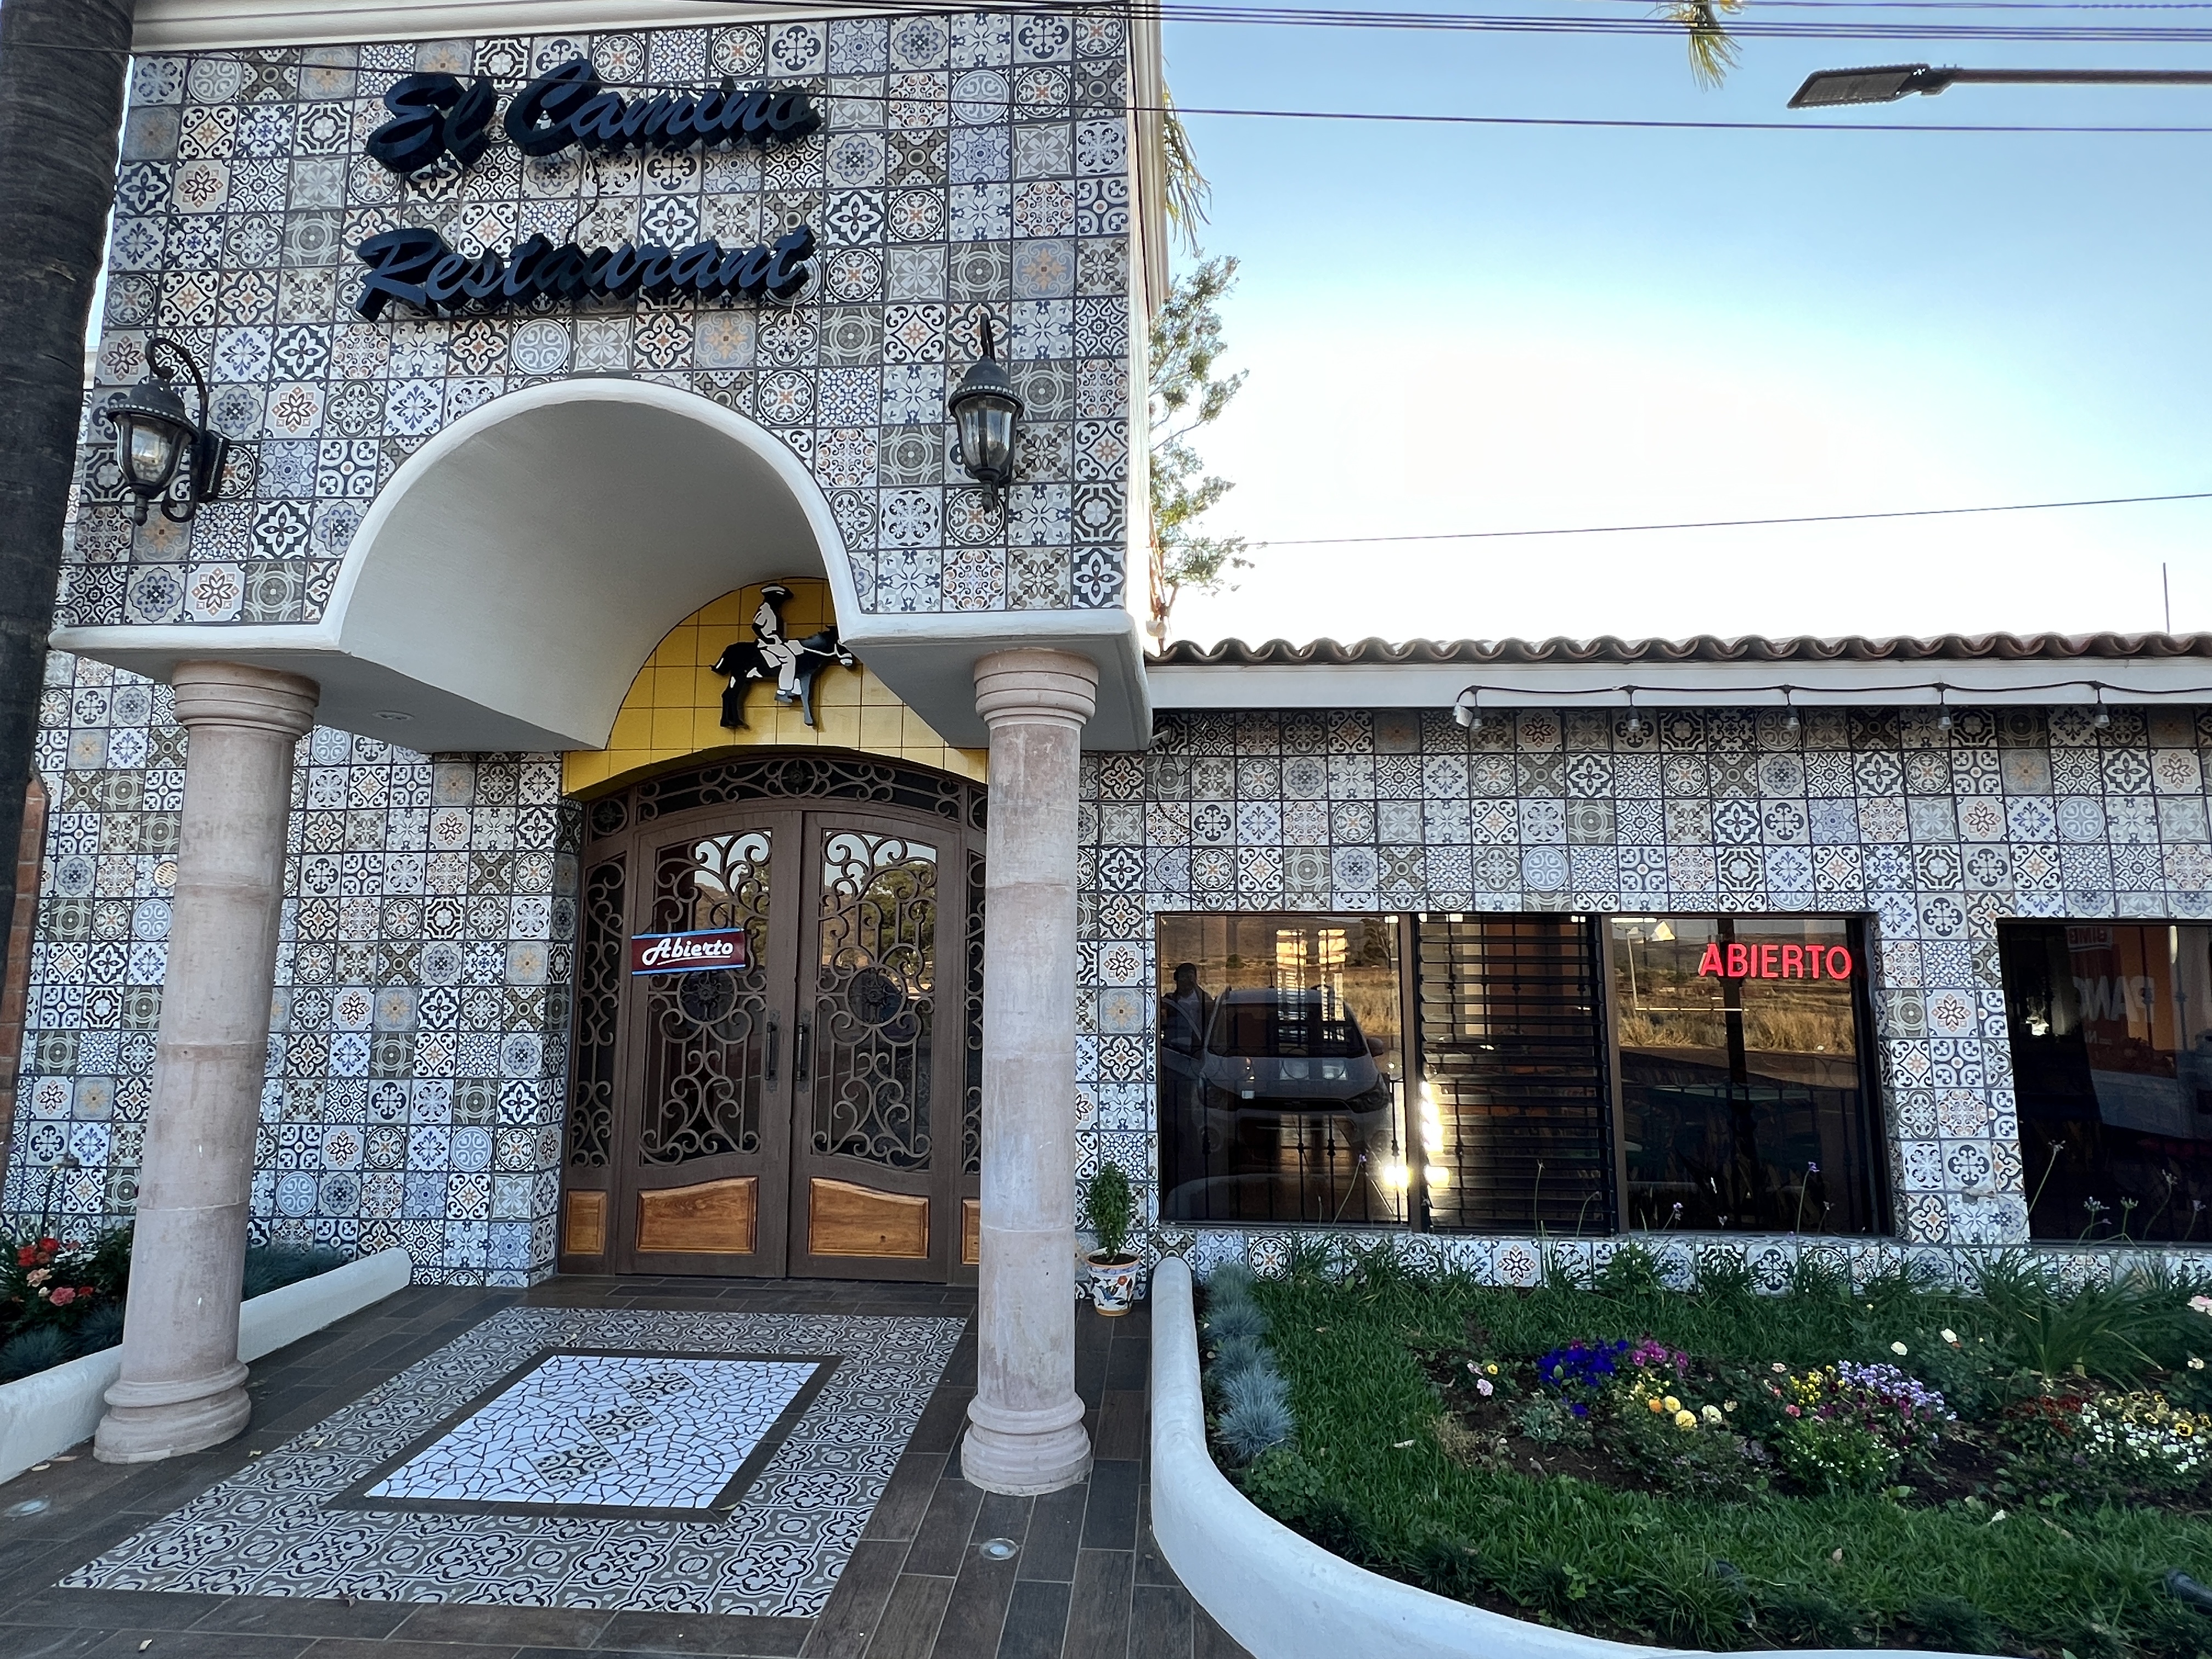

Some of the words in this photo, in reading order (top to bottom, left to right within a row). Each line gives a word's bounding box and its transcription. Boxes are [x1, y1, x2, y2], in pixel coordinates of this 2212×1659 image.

[366, 71, 496, 172] El
[504, 58, 822, 157] Camino
[356, 225, 816, 323] Restaurant
[641, 937, 733, 966] Abierto
[1698, 942, 1853, 980] ABIERTO
